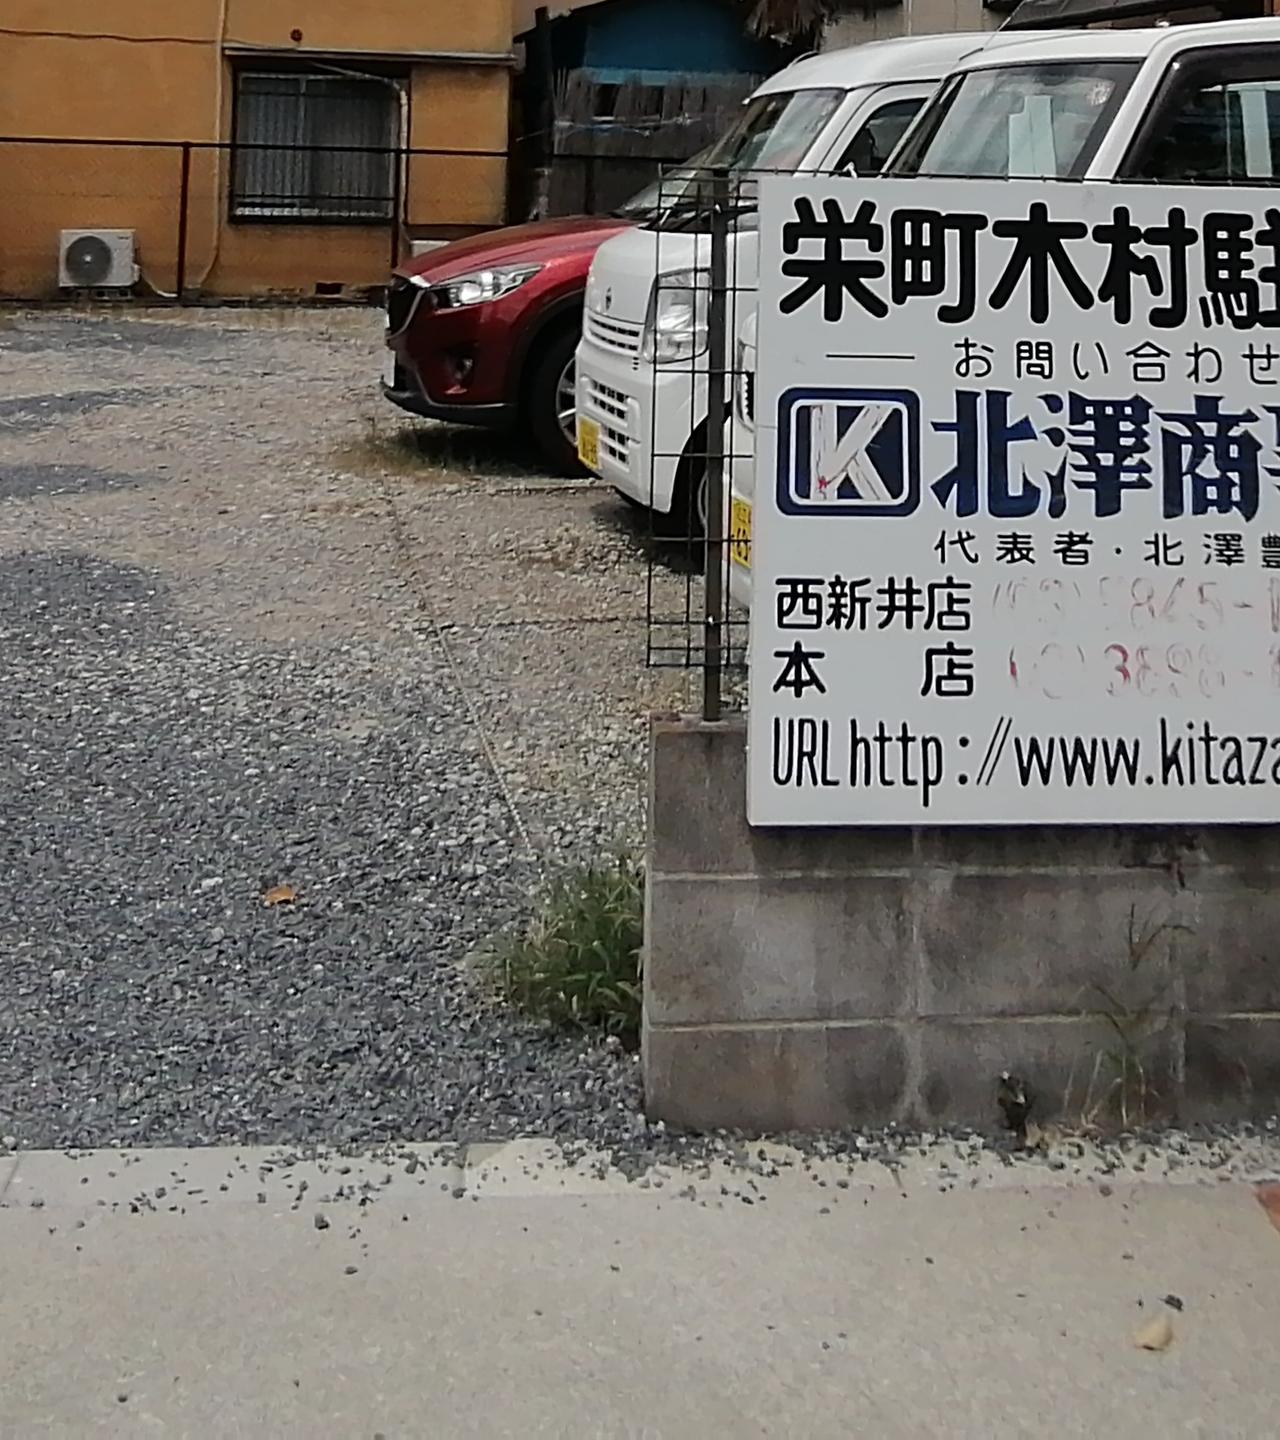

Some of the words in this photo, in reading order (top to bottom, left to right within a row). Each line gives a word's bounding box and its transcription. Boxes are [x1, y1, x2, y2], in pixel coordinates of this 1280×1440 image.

[775, 575, 972, 631] 西新井店
[773, 717, 841, 788] URL
